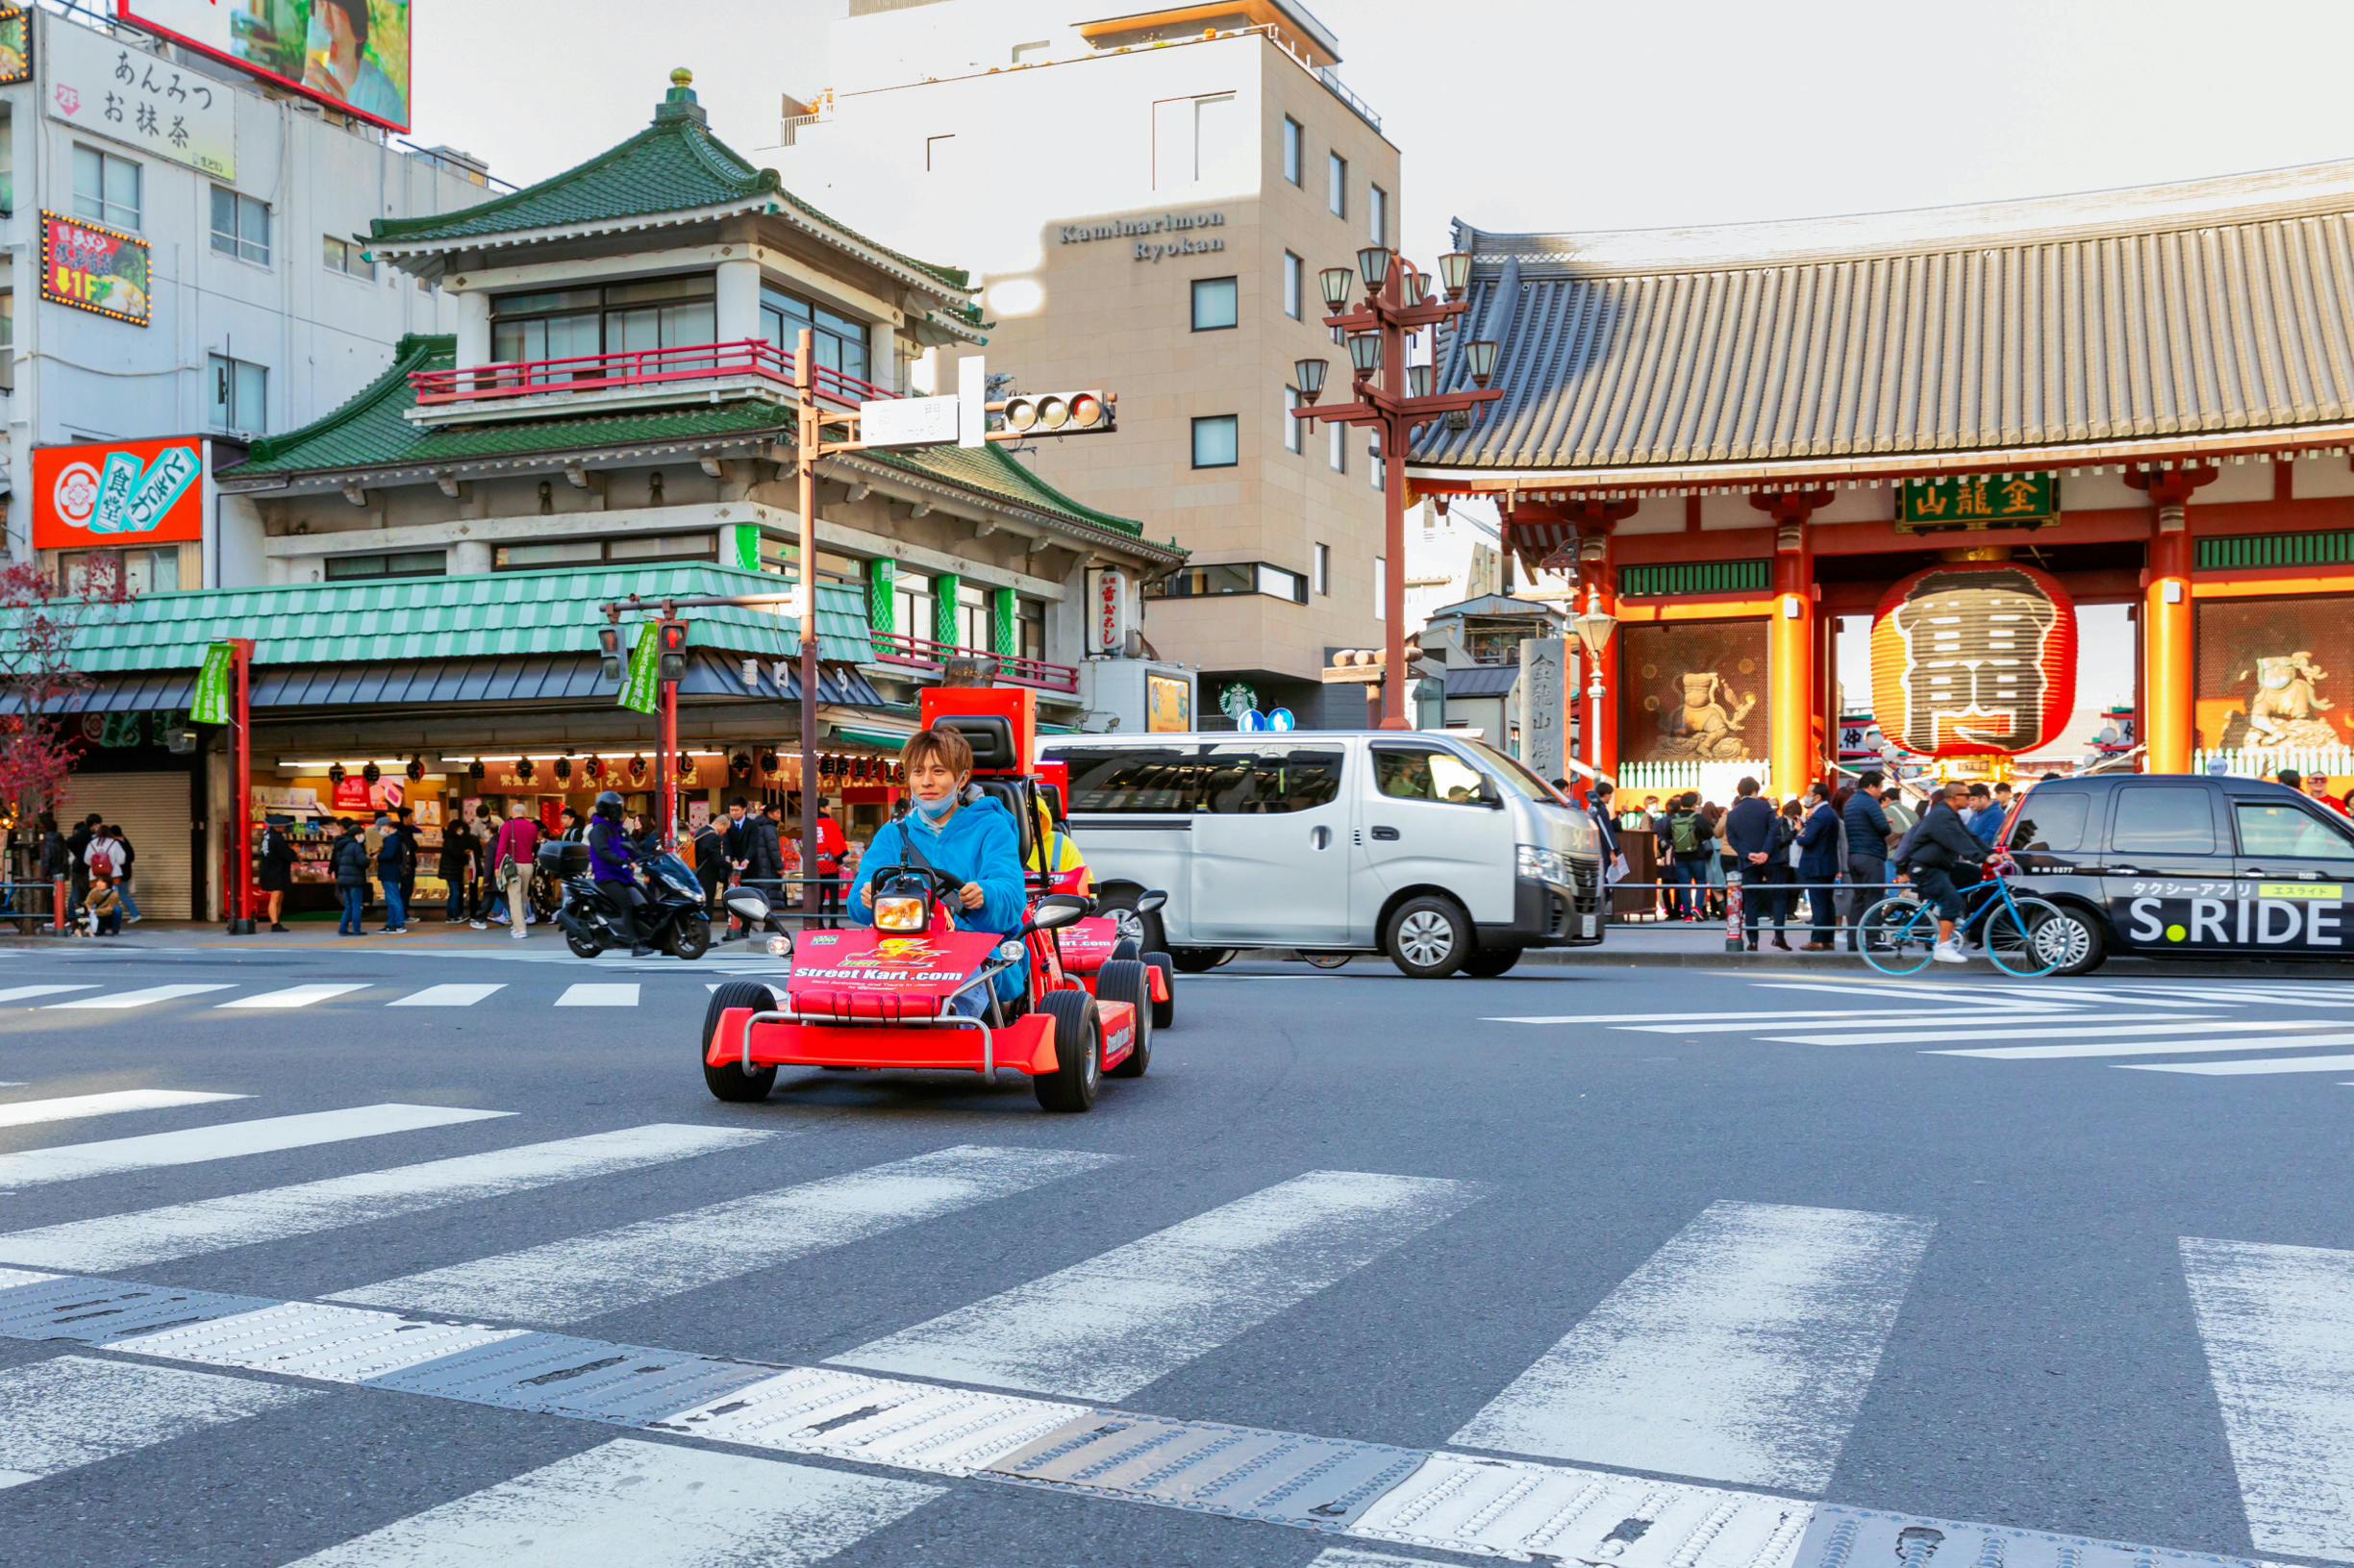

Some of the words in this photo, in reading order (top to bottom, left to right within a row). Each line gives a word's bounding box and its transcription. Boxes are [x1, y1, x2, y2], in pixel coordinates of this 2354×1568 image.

[114, 51, 213, 111] あんみつ
[59, 88, 79, 109] 2F
[104, 90, 189, 149] お抹茶
[1061, 211, 1225, 244] Kaminarimon
[1133, 236, 1225, 263] Ryokan
[71, 270, 98, 302] 1F
[102, 465, 130, 525] 食堂
[130, 453, 186, 524] ときわ
[1892, 568, 2058, 752] 雷門
[2132, 881, 2251, 897] タクシーアプリ
[2273, 886, 2327, 896] エスライト
[2130, 897, 2342, 946] S.RIDE
[794, 967, 861, 979] Street
[862, 968, 909, 981] Kart
